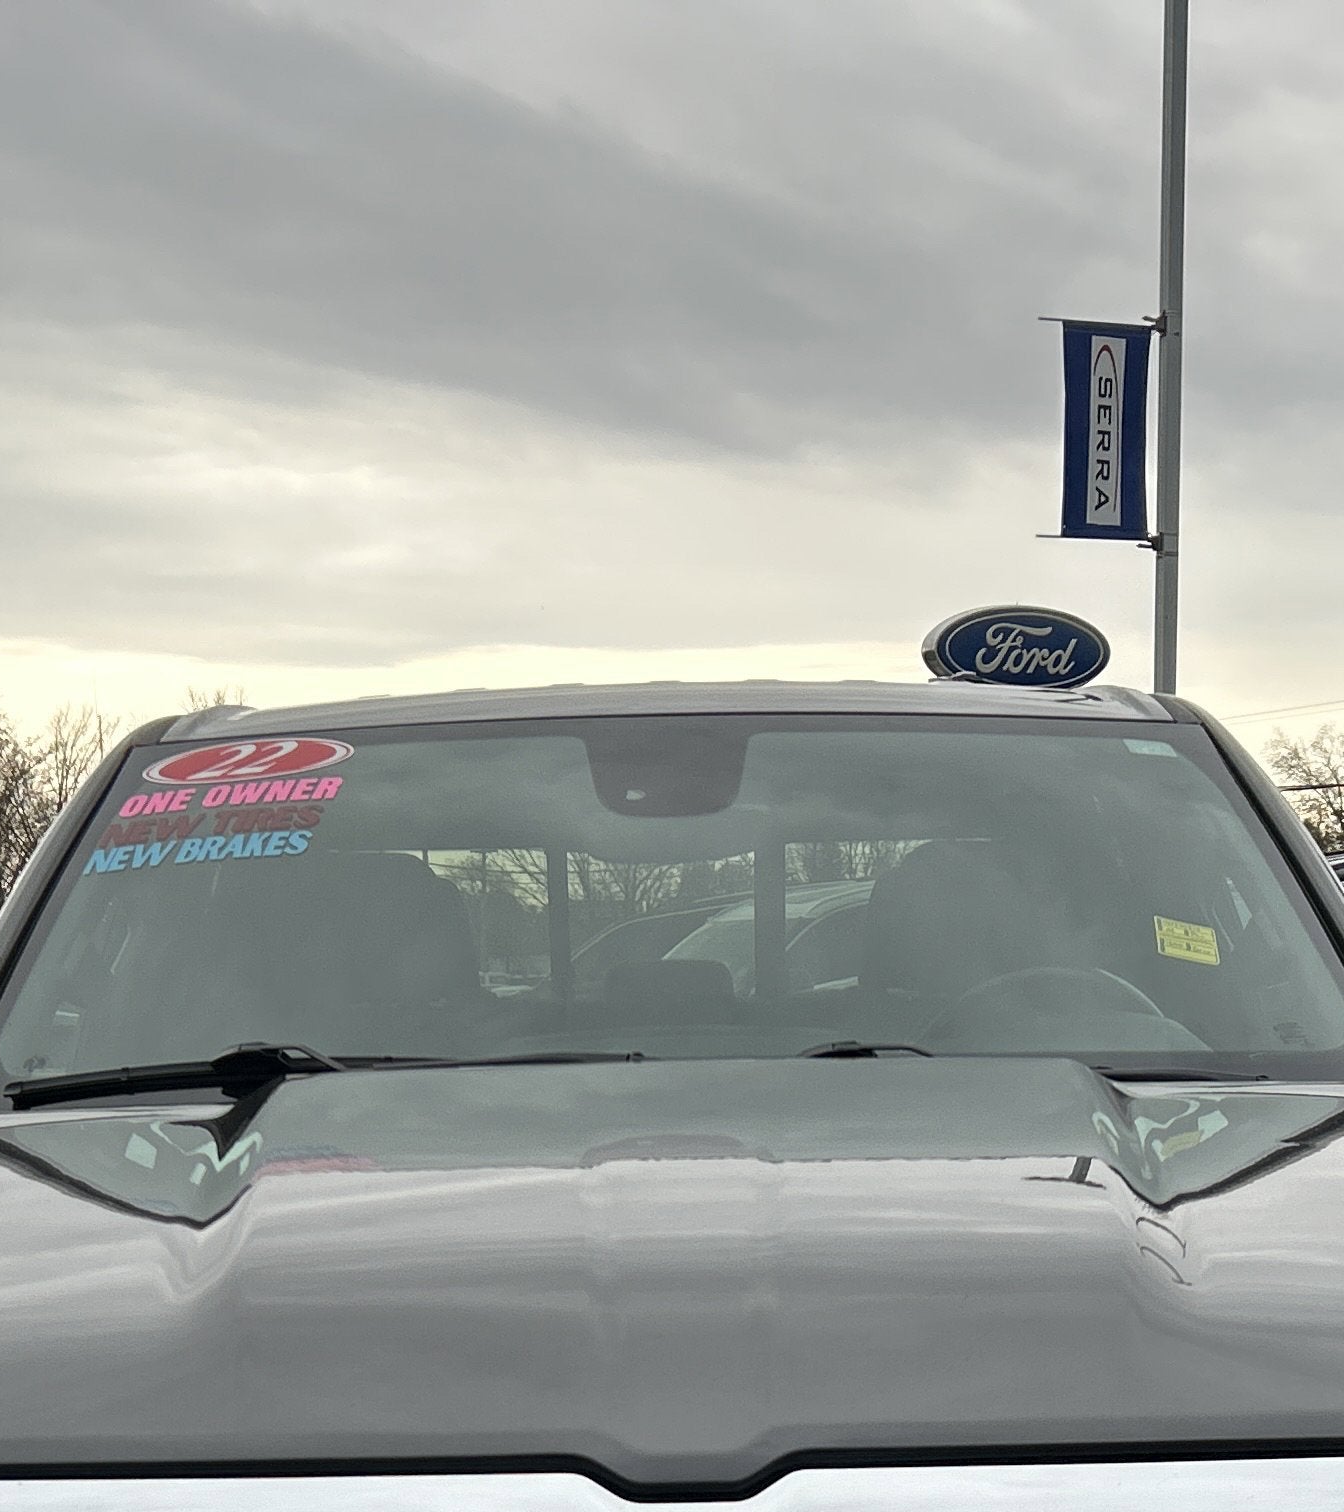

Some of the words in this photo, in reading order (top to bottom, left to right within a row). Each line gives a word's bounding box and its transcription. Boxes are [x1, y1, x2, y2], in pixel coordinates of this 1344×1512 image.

[1094, 375, 1113, 512] SERRA
[975, 622, 1077, 677] Ford
[188, 740, 299, 779] 22
[118, 787, 196, 818] ONE
[201, 776, 343, 808] OWNER
[99, 813, 205, 847] NEW
[213, 804, 324, 834] TIRES
[82, 840, 176, 876] NEW
[174, 830, 313, 864] BRAKES
